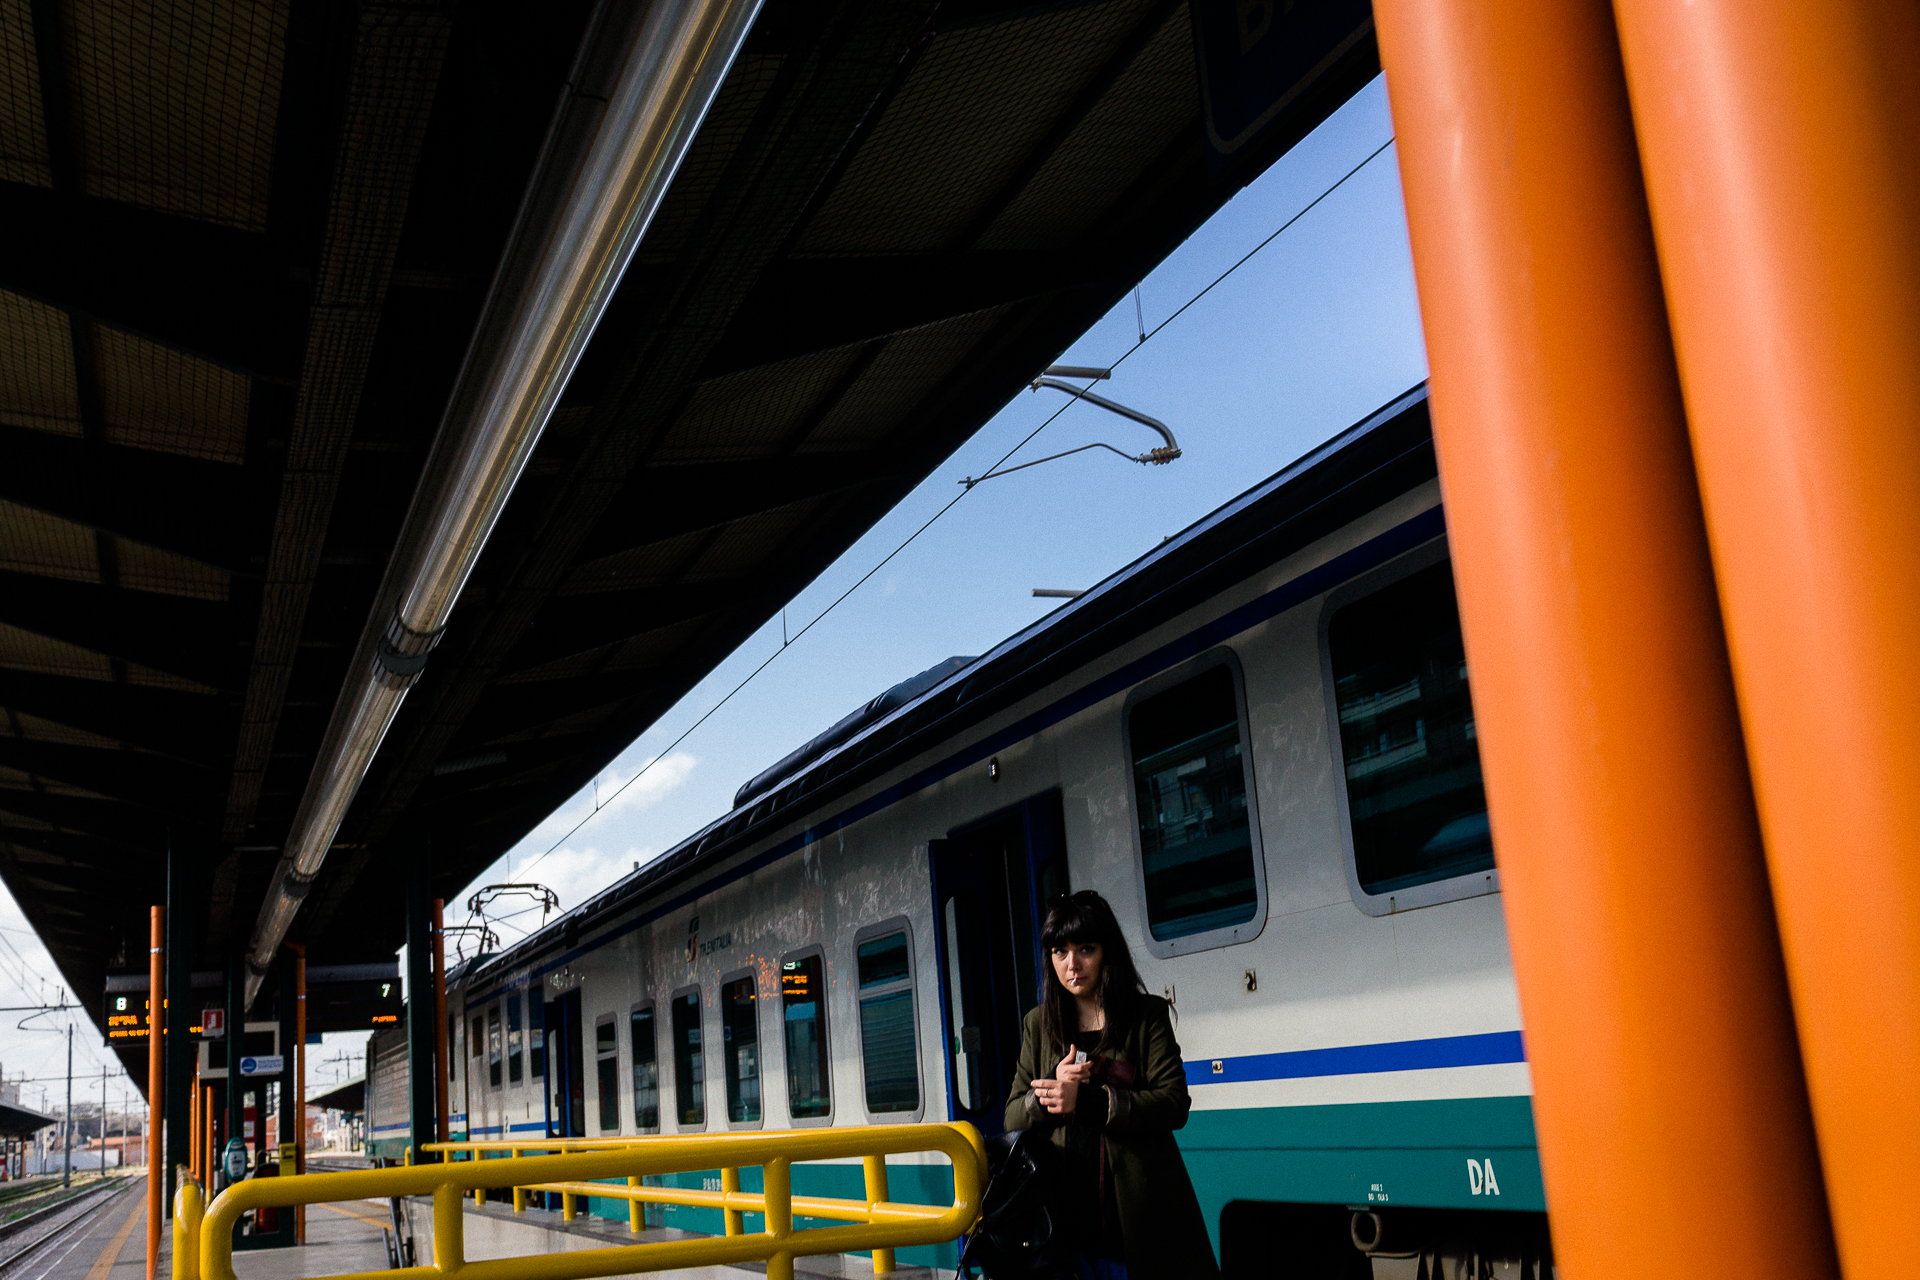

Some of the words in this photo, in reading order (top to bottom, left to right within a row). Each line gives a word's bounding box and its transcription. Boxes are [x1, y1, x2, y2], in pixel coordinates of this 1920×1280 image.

[699, 932, 732, 957] TRENITALIA
[381, 983, 391, 998] 7
[116, 996, 128, 1011] 8
[1466, 1157, 1501, 1196] DA
